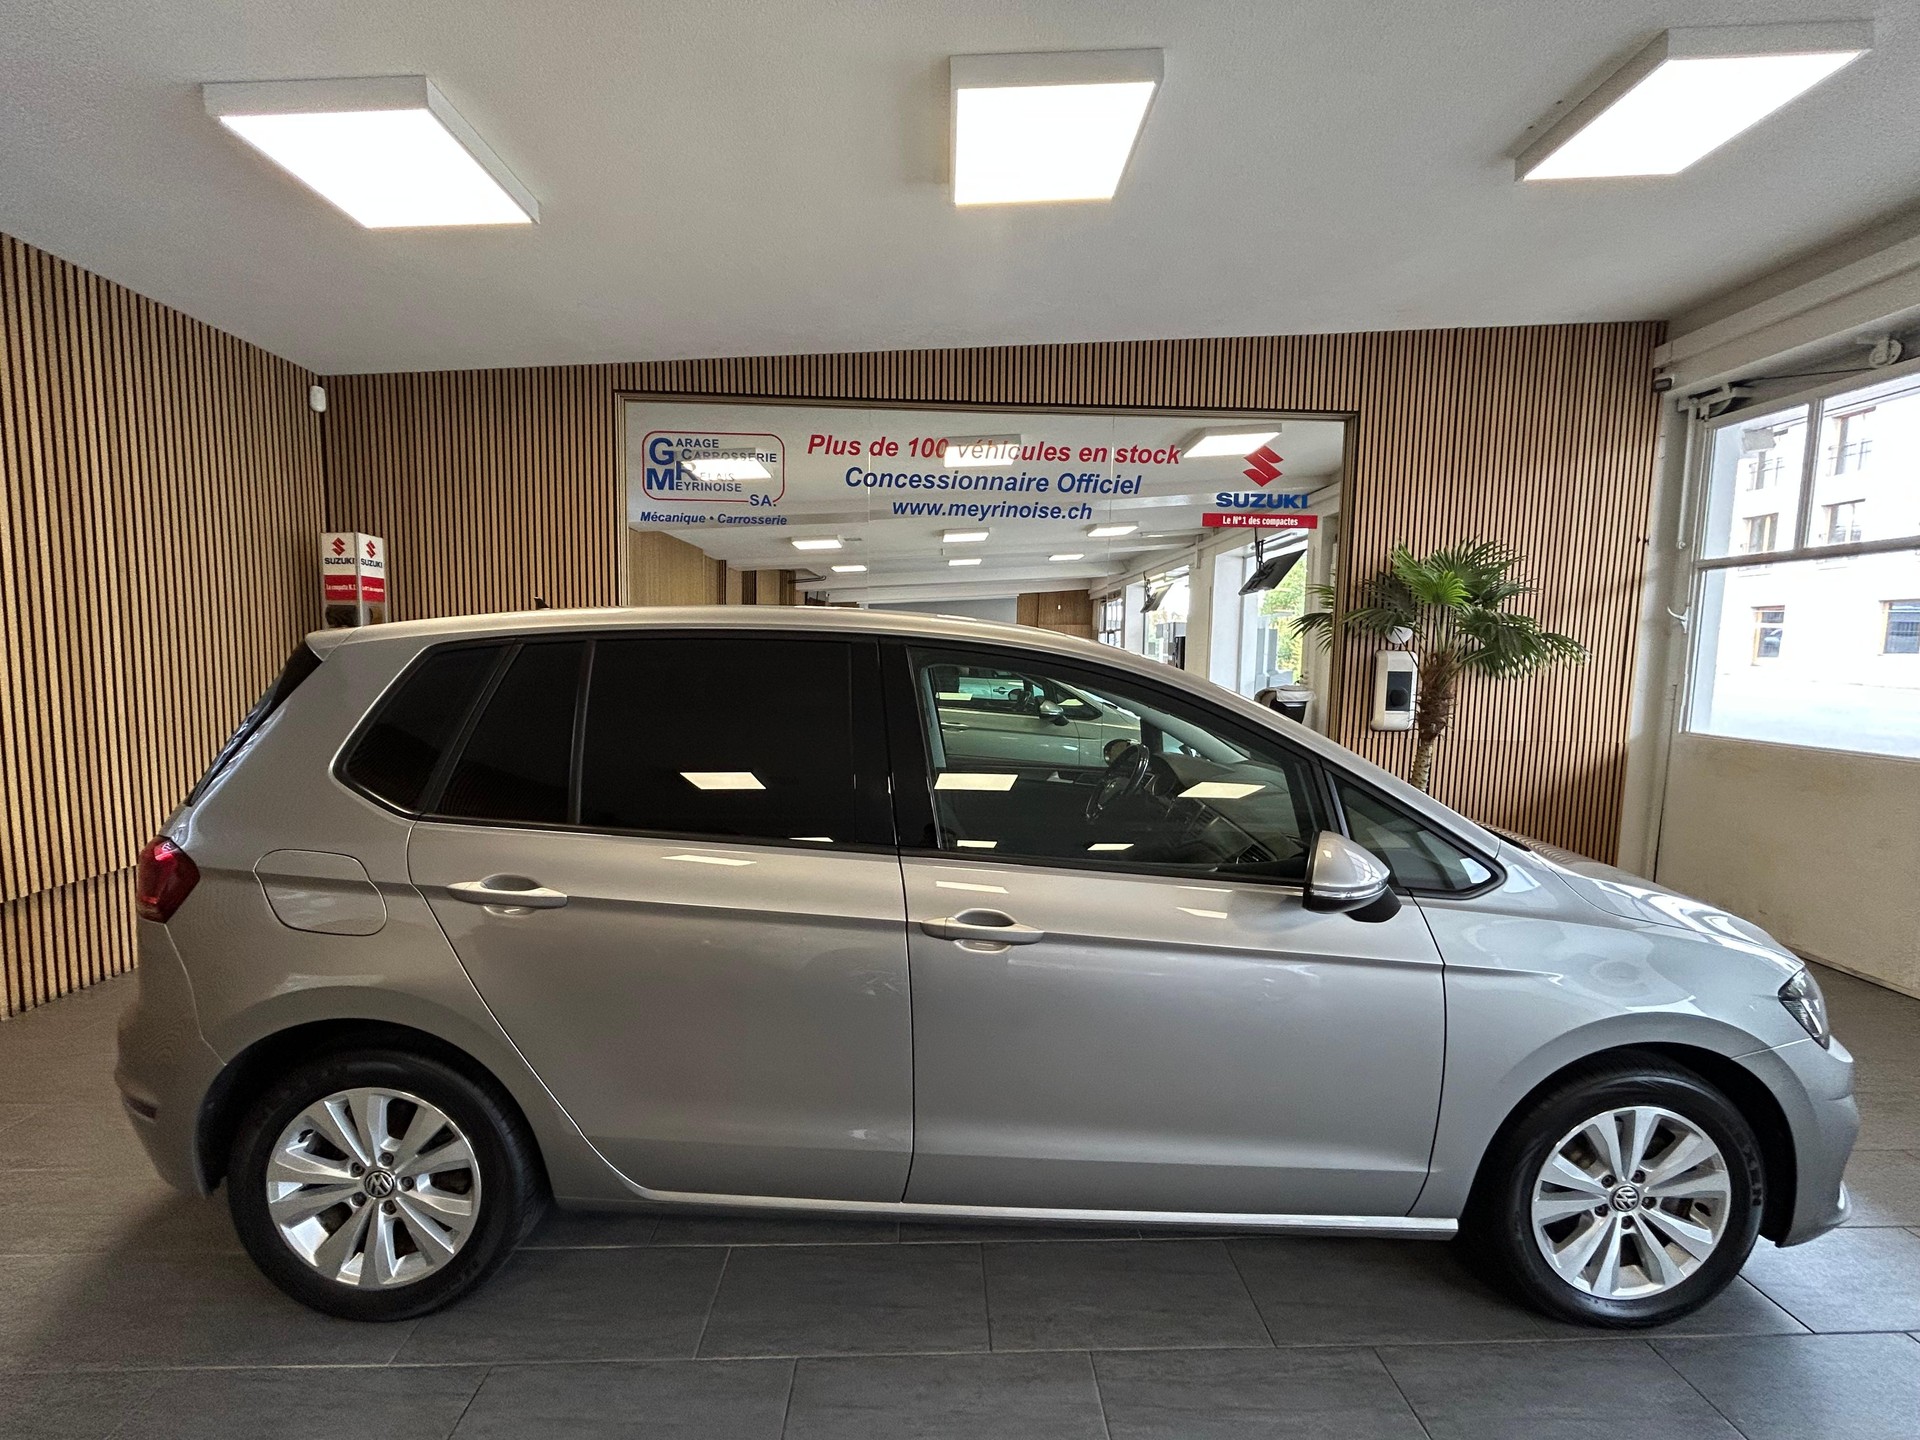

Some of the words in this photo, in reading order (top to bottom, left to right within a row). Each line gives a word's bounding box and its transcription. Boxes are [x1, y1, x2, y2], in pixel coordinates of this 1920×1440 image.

[807, 434, 861, 456] Plus
[869, 436, 899, 457] de
[908, 437, 949, 459] 100
[957, 439, 1071, 462] véhicules
[1078, 446, 1108, 463] en
[1114, 444, 1182, 465] stock
[845, 466, 1050, 492] Concessionnaire
[1057, 472, 1143, 495] Officiel
[1215, 492, 1309, 509] SUZUKI
[640, 511, 706, 525] Mécanique
[717, 513, 788, 526] Carrosserie
[892, 501, 1093, 522] www.meyrinoise.ch
[1222, 515, 1231, 525] Le
[1248, 515, 1261, 526] des
[1261, 517, 1299, 527] compactes
[325, 557, 355, 565] SUZUKI
[361, 558, 383, 568] SUZUKI
